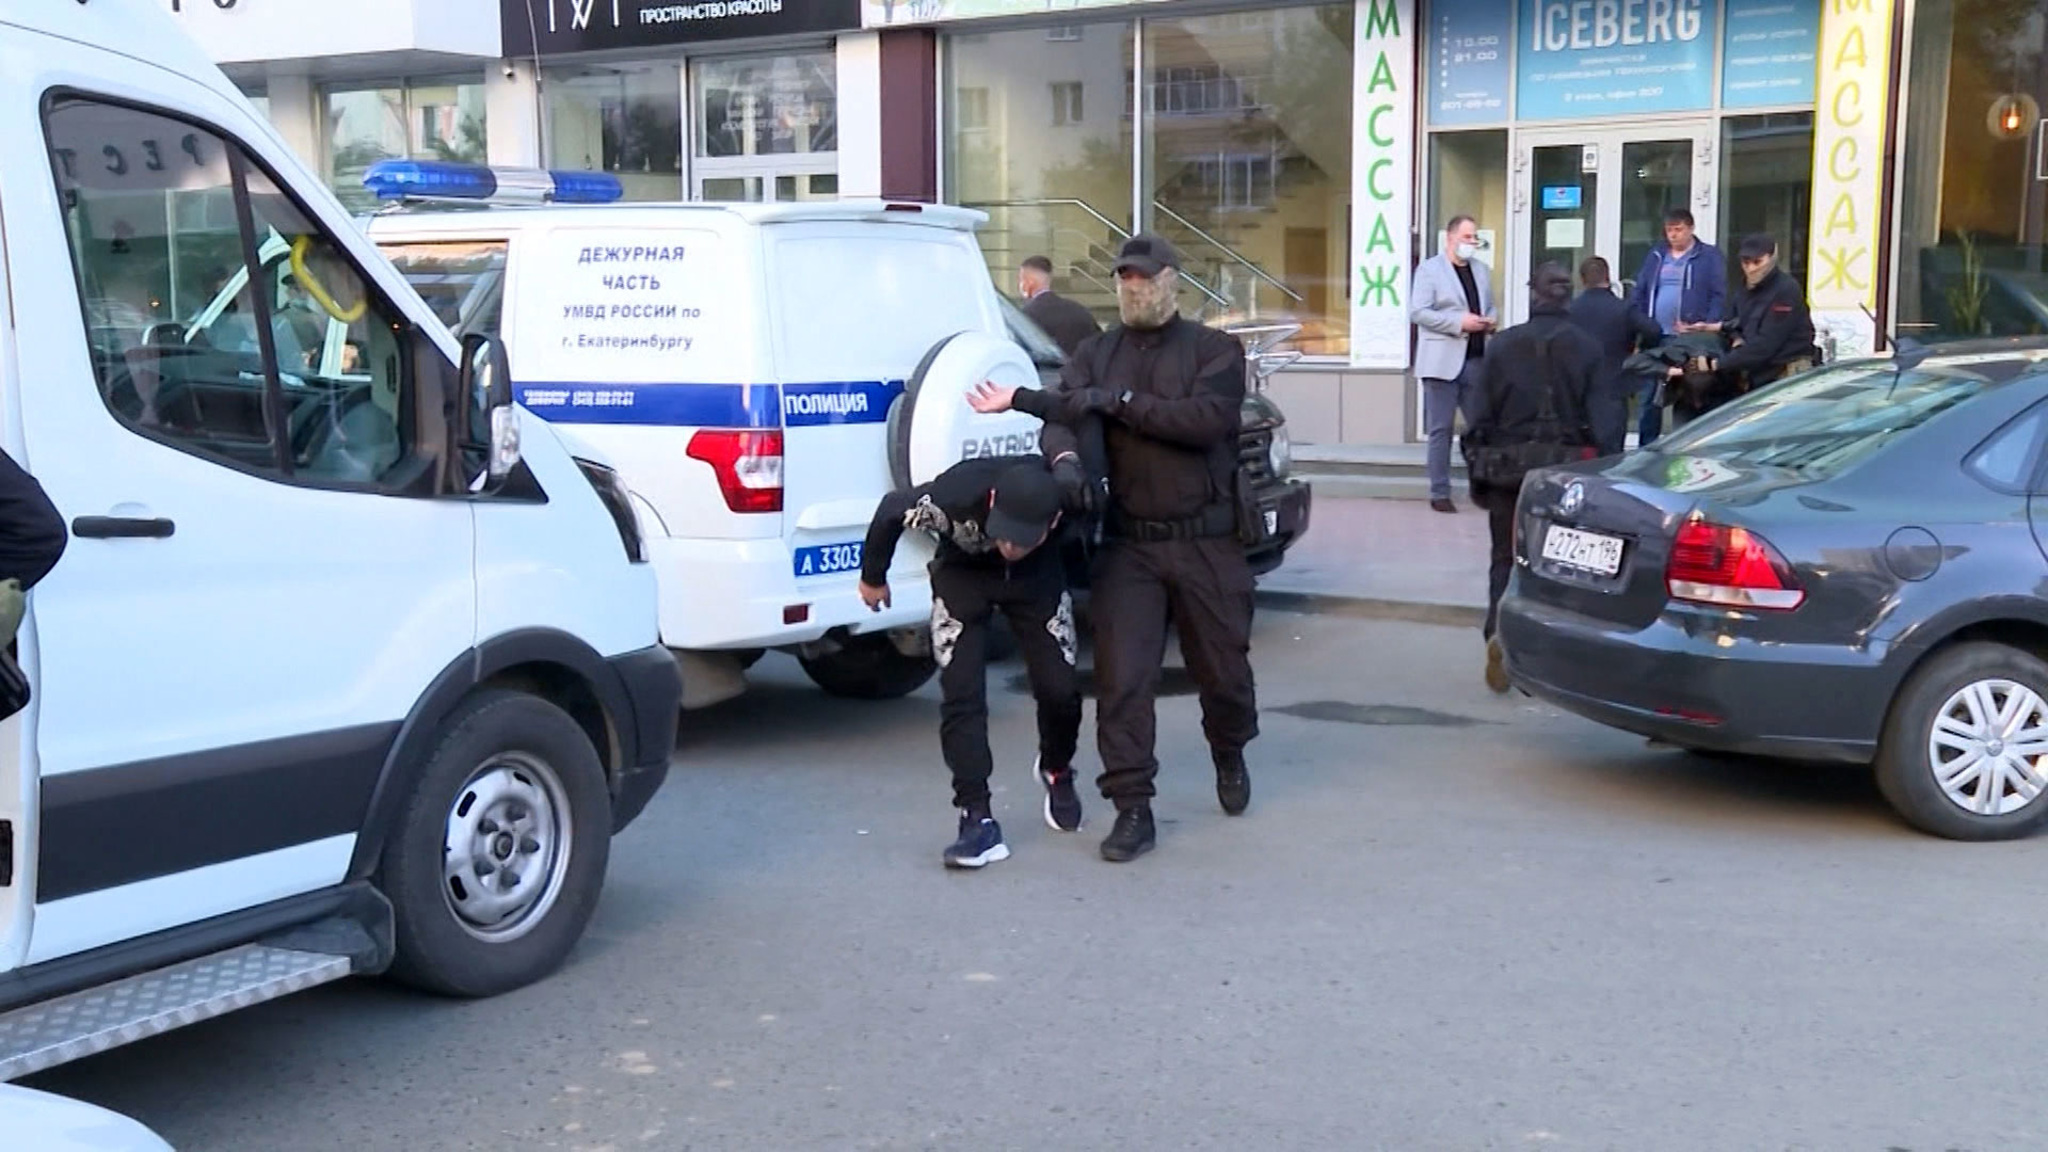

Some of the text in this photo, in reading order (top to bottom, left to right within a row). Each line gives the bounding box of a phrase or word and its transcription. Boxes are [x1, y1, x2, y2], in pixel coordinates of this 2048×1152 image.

[639, 3, 726, 25] ПРОСТРАНСТВО
[727, 0, 782, 16] КРАСОТЫ
[1533, 0, 1700, 51] ICEBERG
[1360, 0, 1400, 307] МАССАЖ
[578, 246, 685, 265] ДЕЖУРНАЯ
[602, 274, 661, 291] ЧАСТЬ
[563, 304, 701, 321] УМВД РОССИИ по
[577, 333, 693, 351] Екатеринбургу
[784, 391, 869, 416] ПОЛИЦИЯ
[819, 544, 862, 572] 3303
